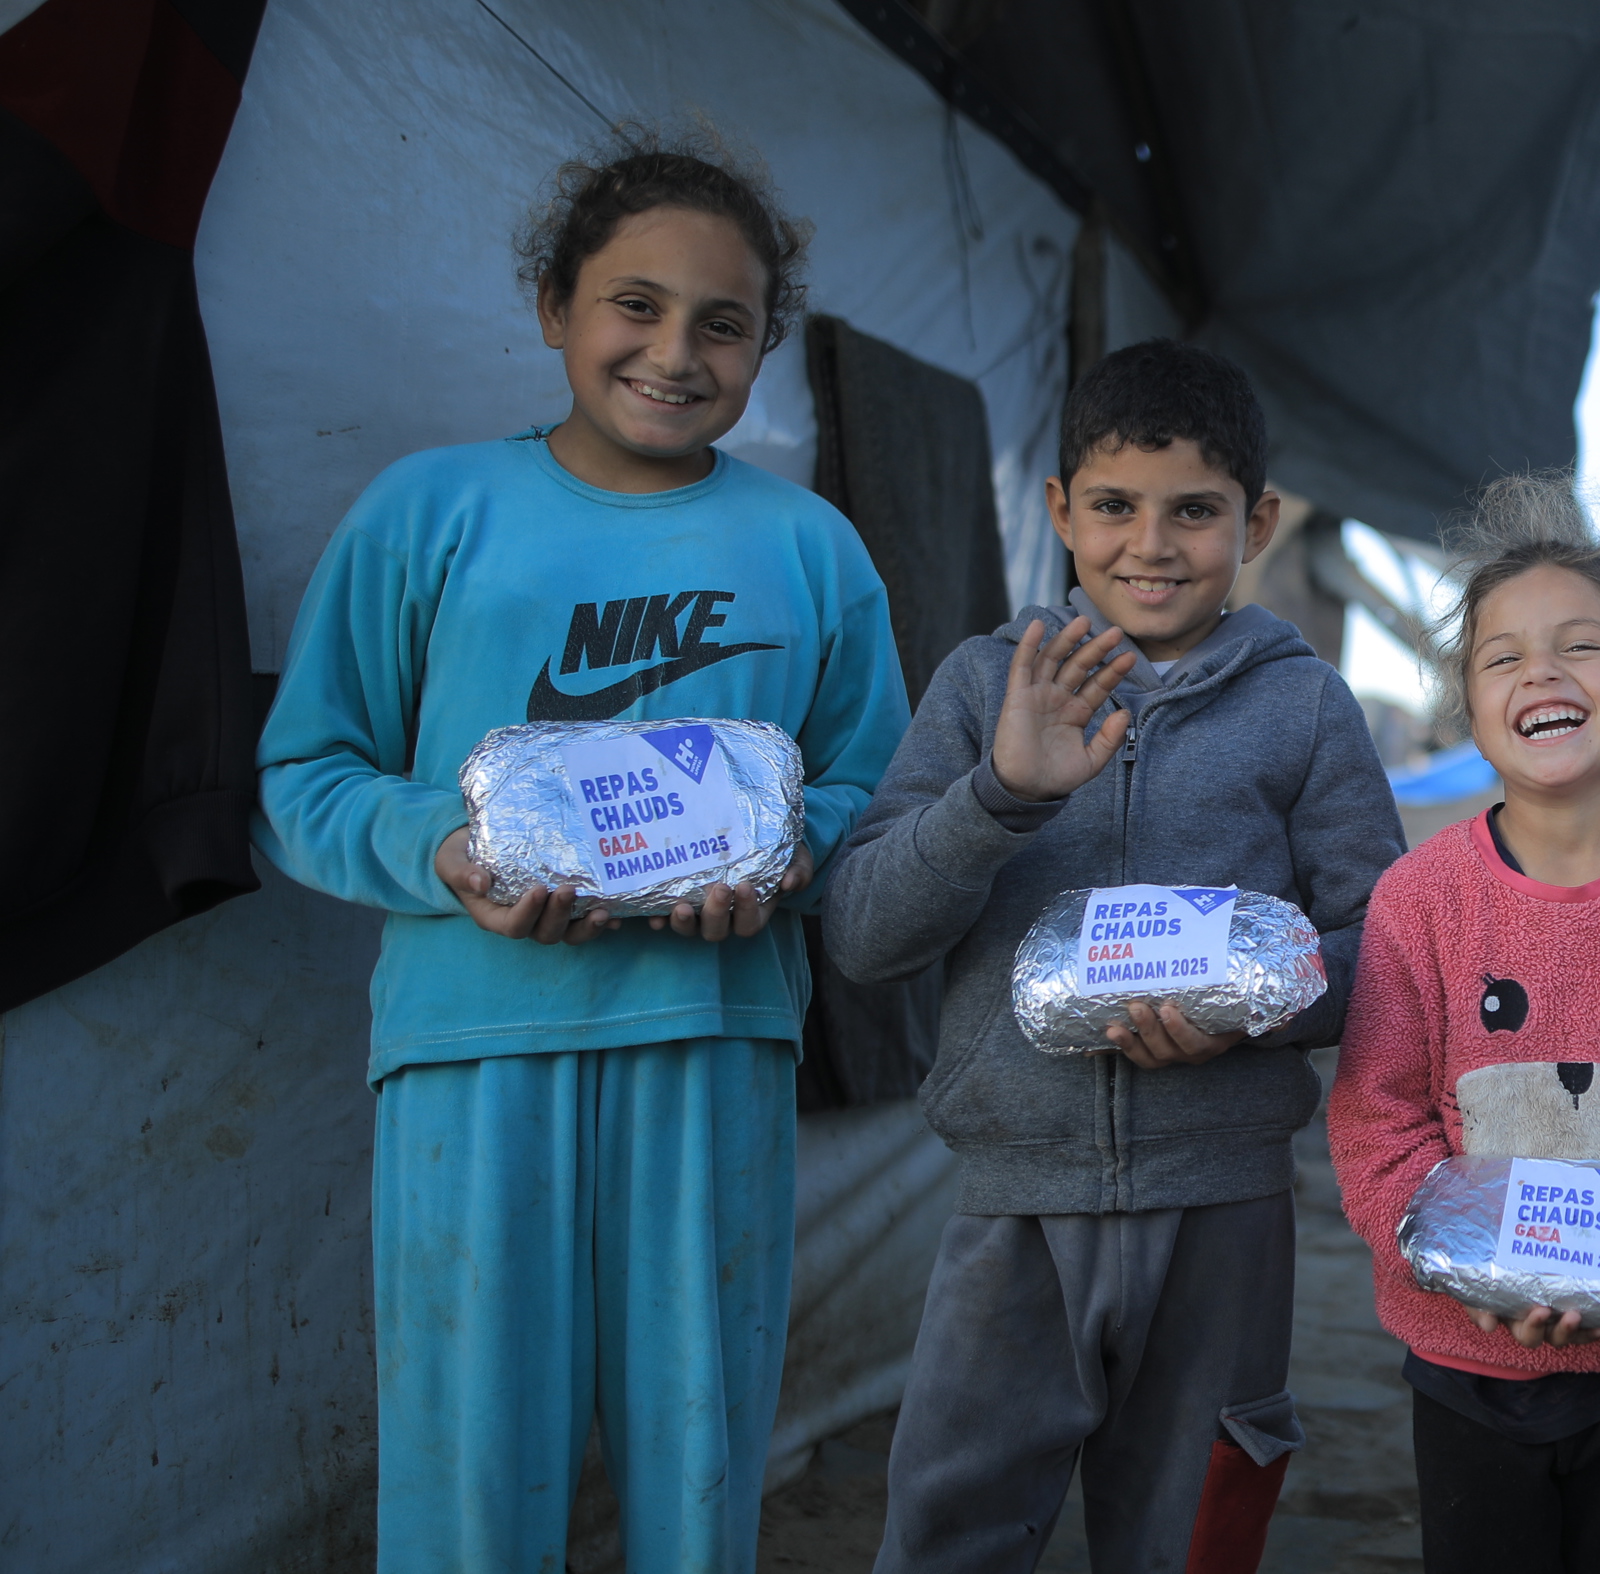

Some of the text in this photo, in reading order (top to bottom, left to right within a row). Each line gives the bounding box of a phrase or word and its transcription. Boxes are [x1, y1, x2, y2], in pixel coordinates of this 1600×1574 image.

[559, 590, 736, 676] NIKE
[580, 767, 659, 804] REPAS
[590, 792, 685, 832] CHAUDS
[598, 831, 648, 858] GAZA
[604, 835, 729, 881] RAMADAN 2025
[1094, 901, 1168, 920] REPAS
[1091, 918, 1182, 942] CHAUDS
[1087, 943, 1134, 962] GAZA
[1086, 957, 1209, 985] RAMADAN 2025
[1520, 1184, 1595, 1206] REPAS
[1514, 1223, 1562, 1245] GAZA
[1511, 1239, 1593, 1266] RAMADAN
